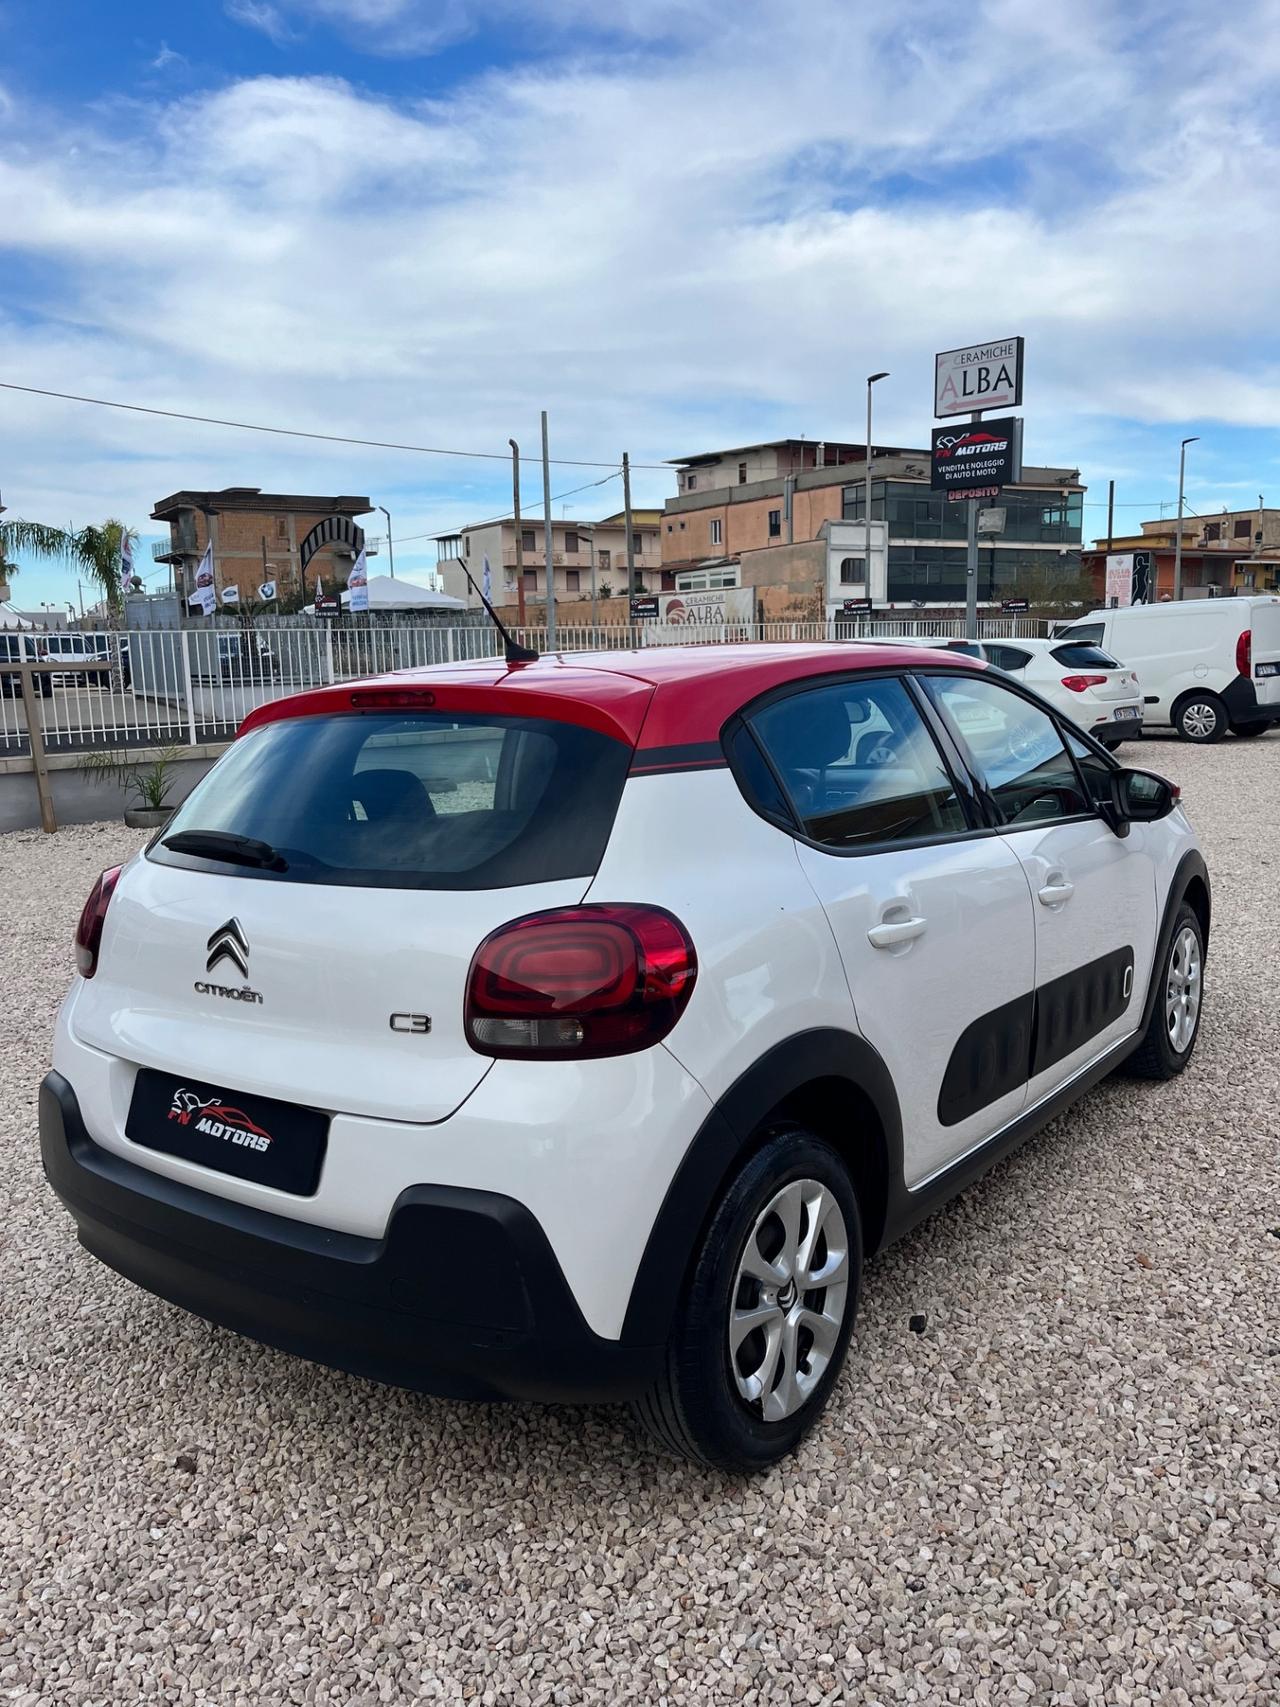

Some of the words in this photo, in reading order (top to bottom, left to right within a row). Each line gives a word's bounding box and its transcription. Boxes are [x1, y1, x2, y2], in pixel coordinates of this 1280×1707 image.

[953, 344, 1013, 365] CERAMICHE
[940, 363, 1014, 400] ALBA
[955, 441, 1008, 456] MOTORS
[938, 463, 965, 473] VENDITA
[971, 458, 1005, 469] NOLEGGIO
[953, 471, 971, 479] AUTO
[976, 468, 997, 476] MOTO
[948, 486, 999, 500] DEPOSITO
[686, 605, 724, 621] ALBA
[194, 981, 264, 1004] CITROËN
[389, 1012, 432, 1034] C3
[168, 1110, 193, 1125] FN
[195, 1117, 270, 1152] MOTORS
